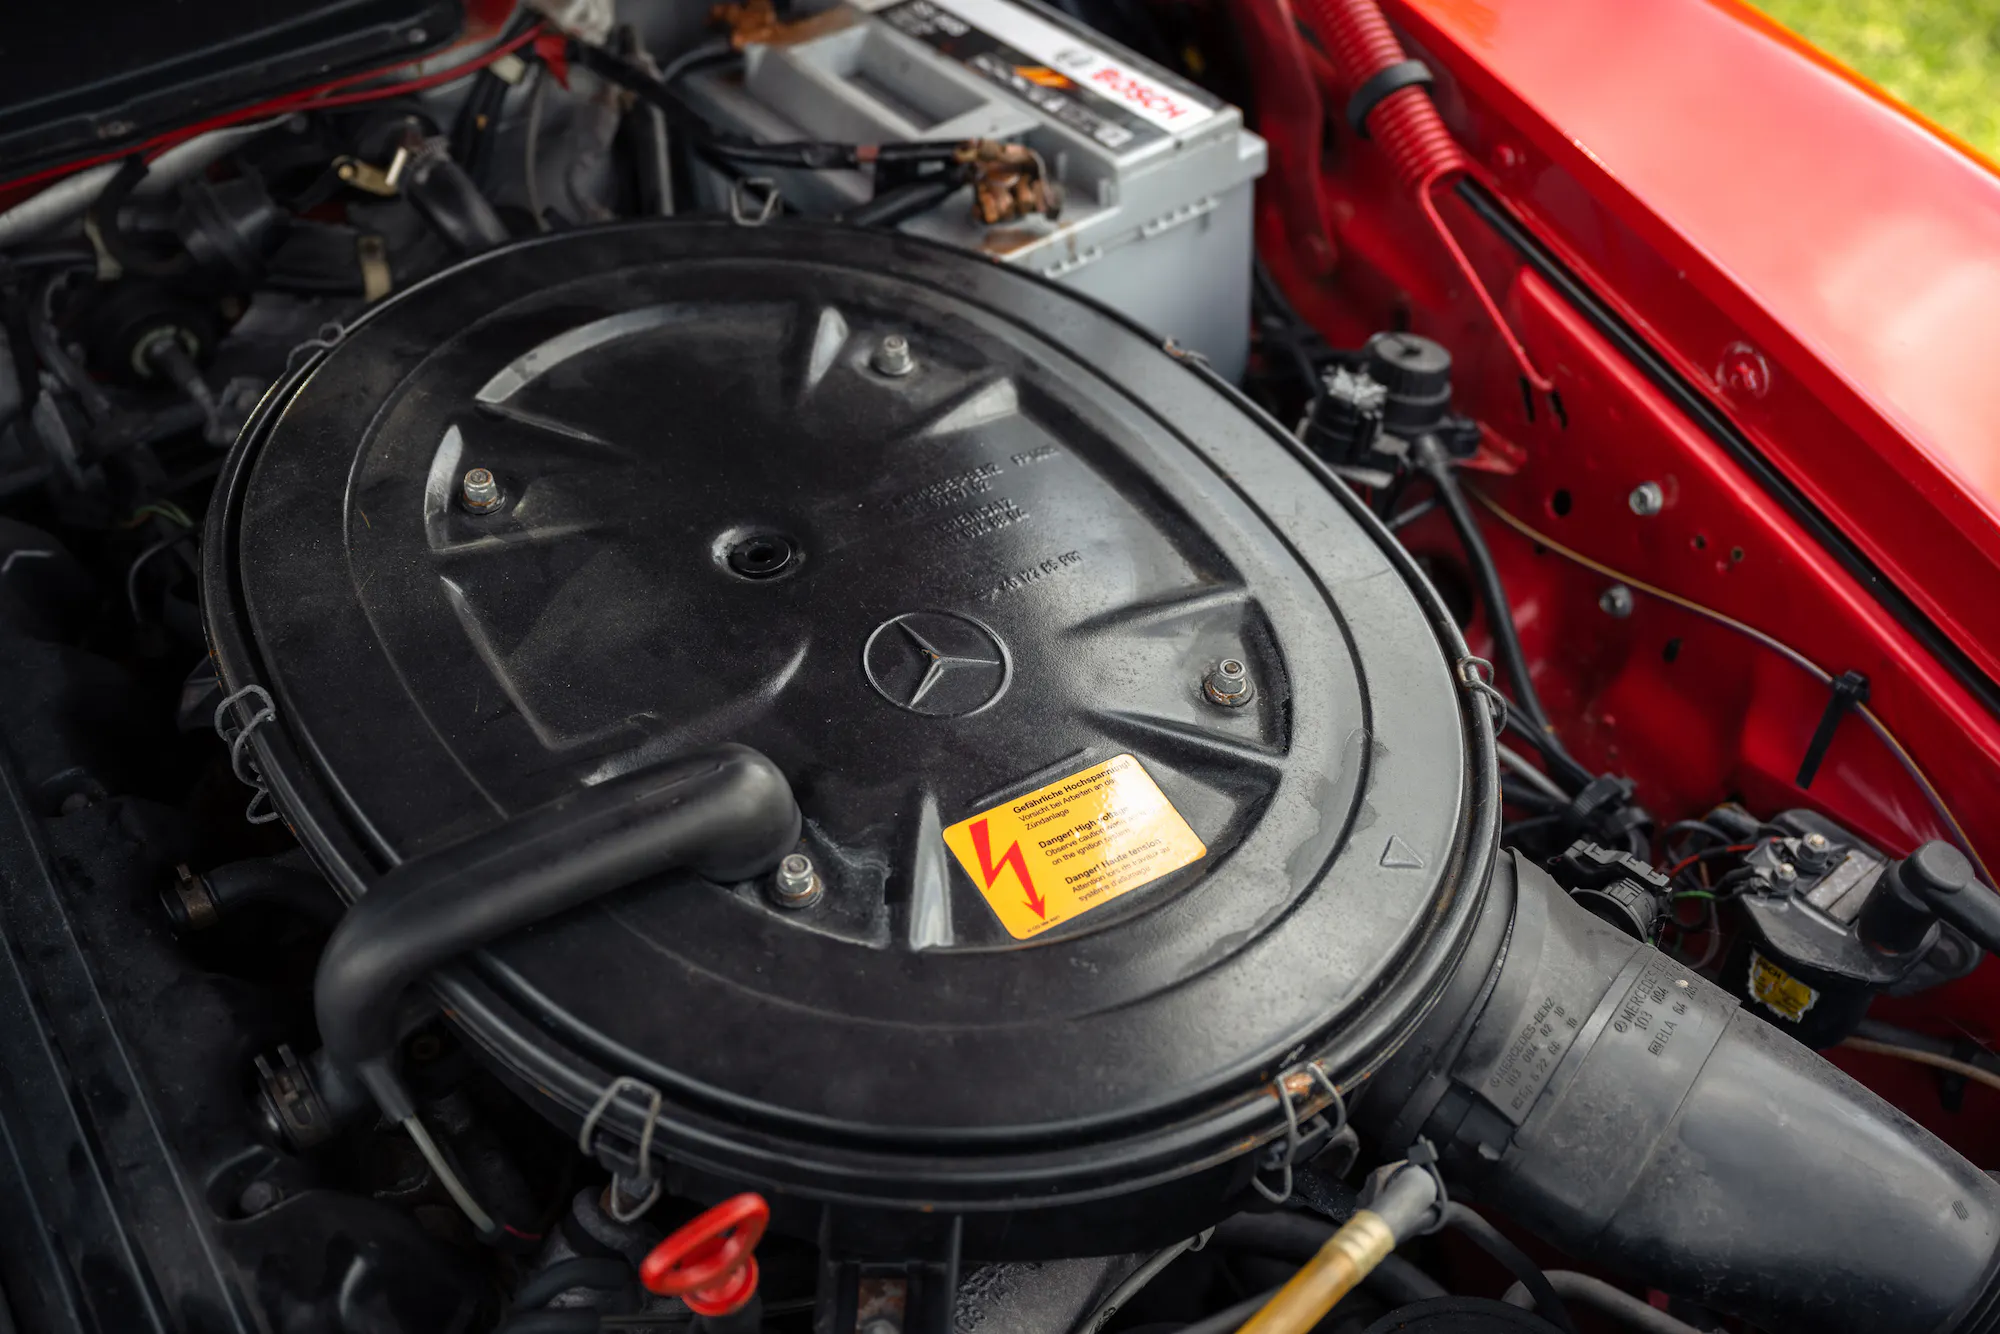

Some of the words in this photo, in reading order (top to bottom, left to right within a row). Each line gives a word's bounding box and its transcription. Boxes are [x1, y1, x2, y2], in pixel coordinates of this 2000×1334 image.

[1092, 68, 1187, 119] BOSCH
[1013, 789, 1064, 814] Gefährliche
[1063, 760, 1131, 793] Hochspannung!
[1018, 805, 1050, 822] Vorsicht
[1050, 800, 1063, 811] bei
[1063, 787, 1094, 805] Arbeiten
[1094, 782, 1104, 791] an
[1025, 808, 1070, 831] Zündanlage
[1038, 828, 1075, 849] Danger!
[1074, 819, 1097, 834] High
[1045, 840, 1078, 857] Observe
[1078, 827, 1105, 843] caution
[1052, 858, 1063, 866] on
[1062, 850, 1076, 861] the
[1077, 839, 1104, 855] ignition
[1065, 863, 1101, 885] Danger!
[1101, 854, 1128, 868] Haute
[1128, 838, 1162, 856] tension
[1072, 874, 1106, 893] Attention
[1634, 1010, 1653, 1030] 103
[1496, 996, 1556, 1079] MERCEDES-BENZ
